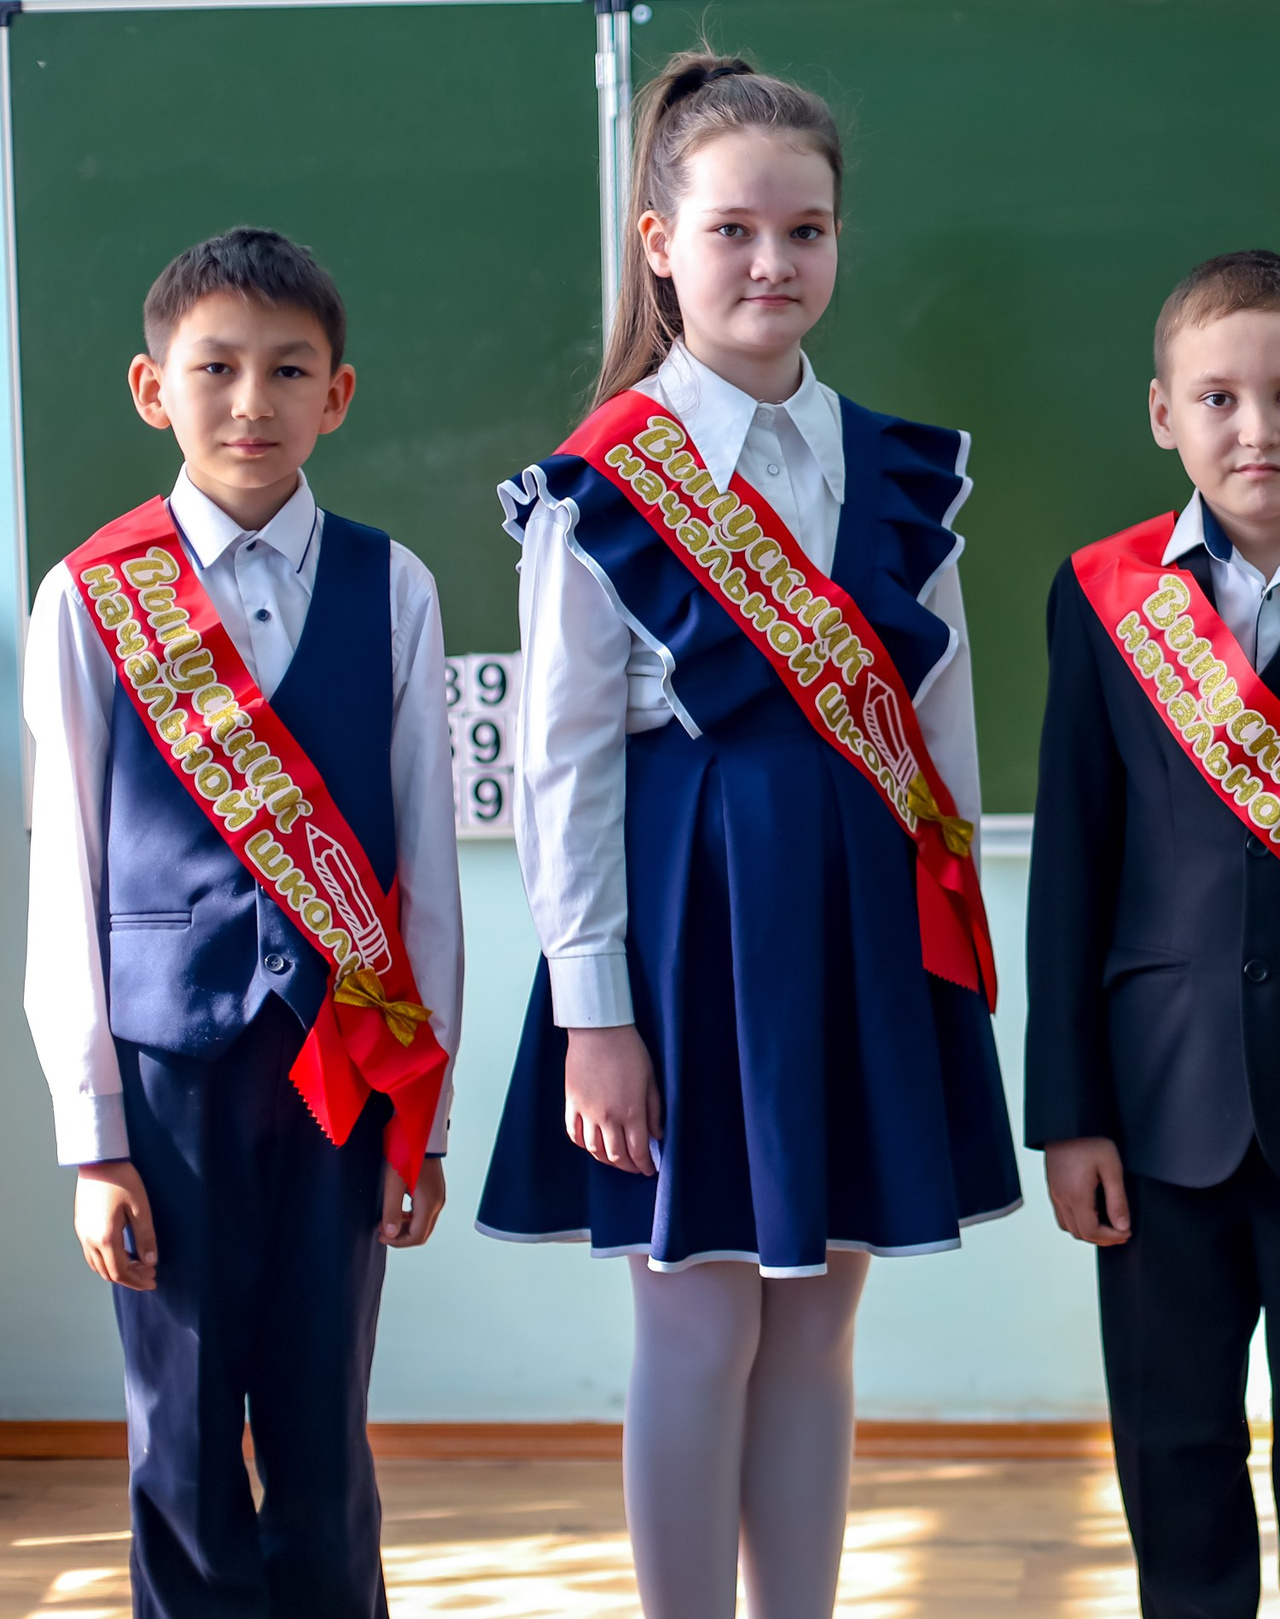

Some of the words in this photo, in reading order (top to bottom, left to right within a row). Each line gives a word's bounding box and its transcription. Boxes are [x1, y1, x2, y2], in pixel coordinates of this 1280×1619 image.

[605, 444, 830, 687] начальной
[633, 416, 874, 686] Выпускник
[80, 563, 264, 832] начальной
[120, 546, 313, 834] Выпускник
[474, 777, 503, 822] 9
